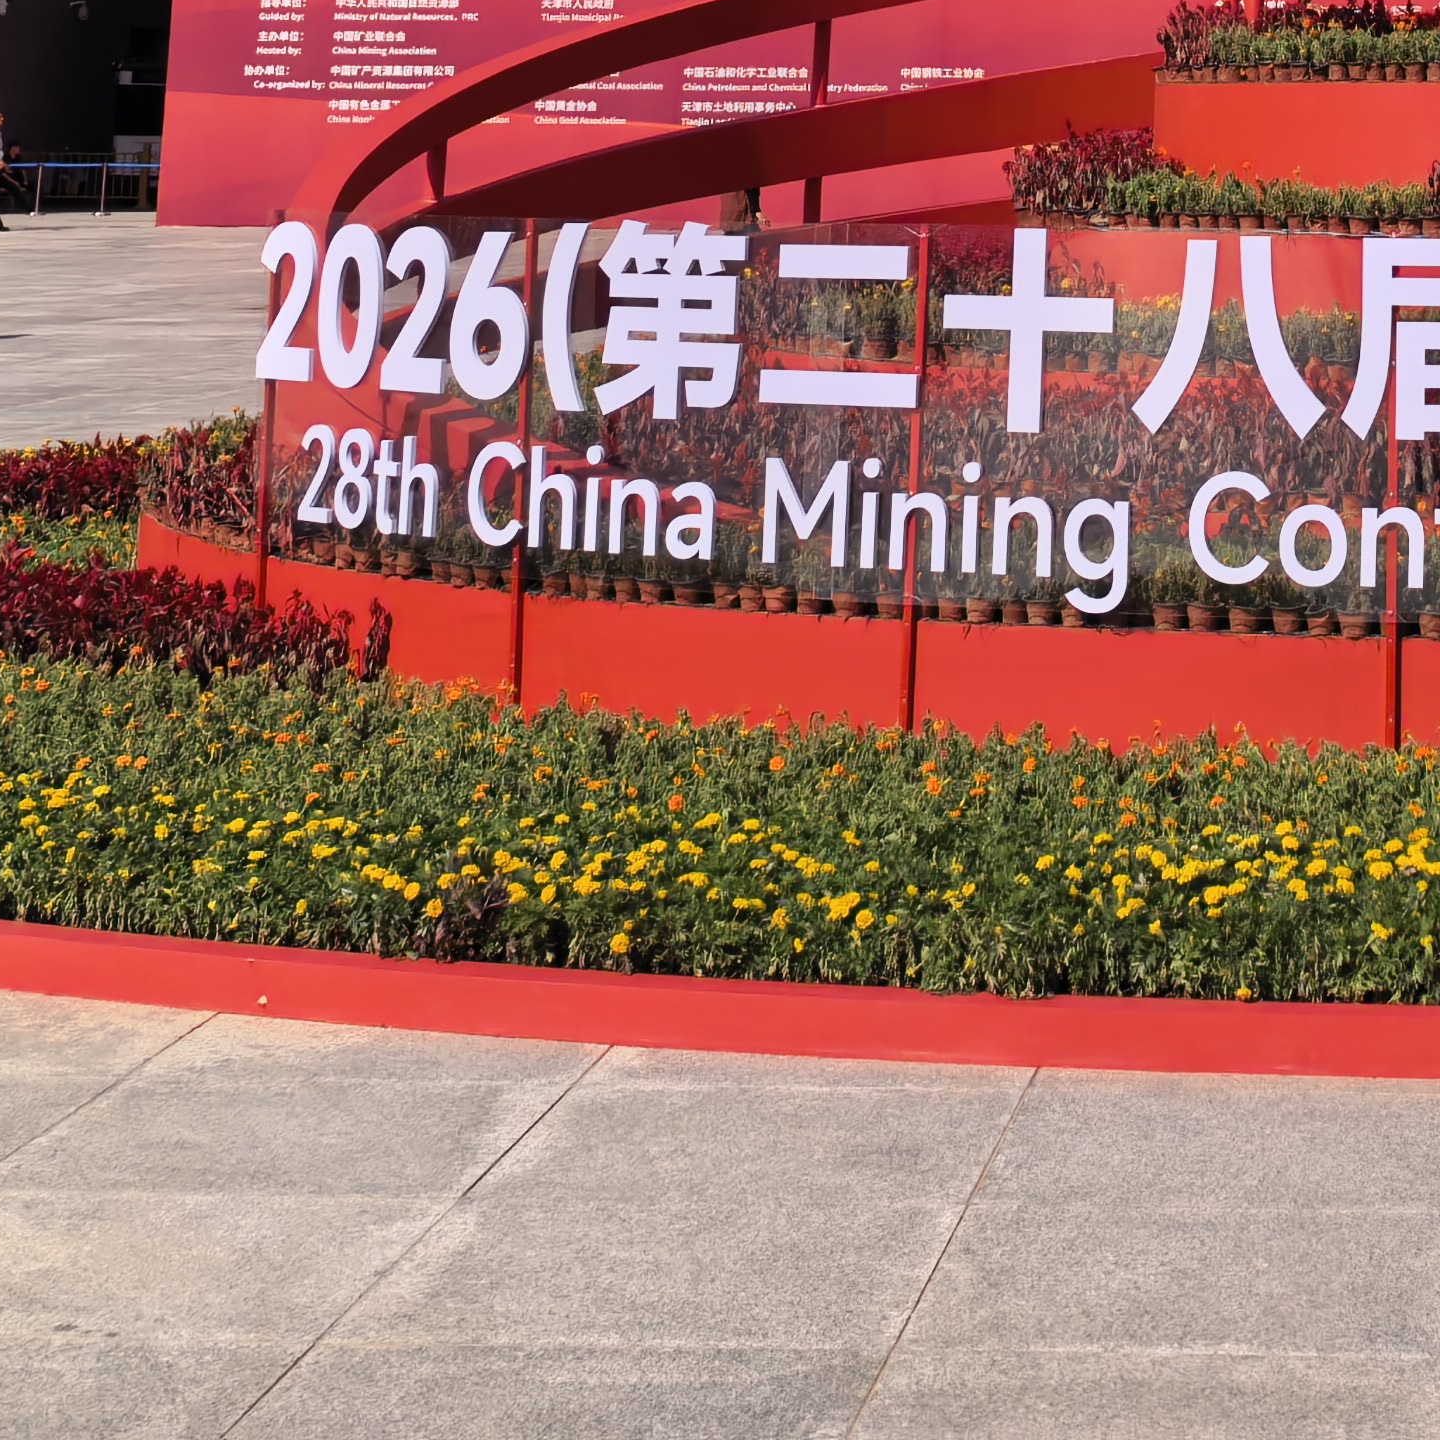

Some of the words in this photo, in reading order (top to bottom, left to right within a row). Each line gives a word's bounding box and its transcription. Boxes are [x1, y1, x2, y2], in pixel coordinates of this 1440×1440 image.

[296, 423, 441, 539] 28th
[467, 440, 717, 562] China
[761, 455, 1130, 615] Mining
